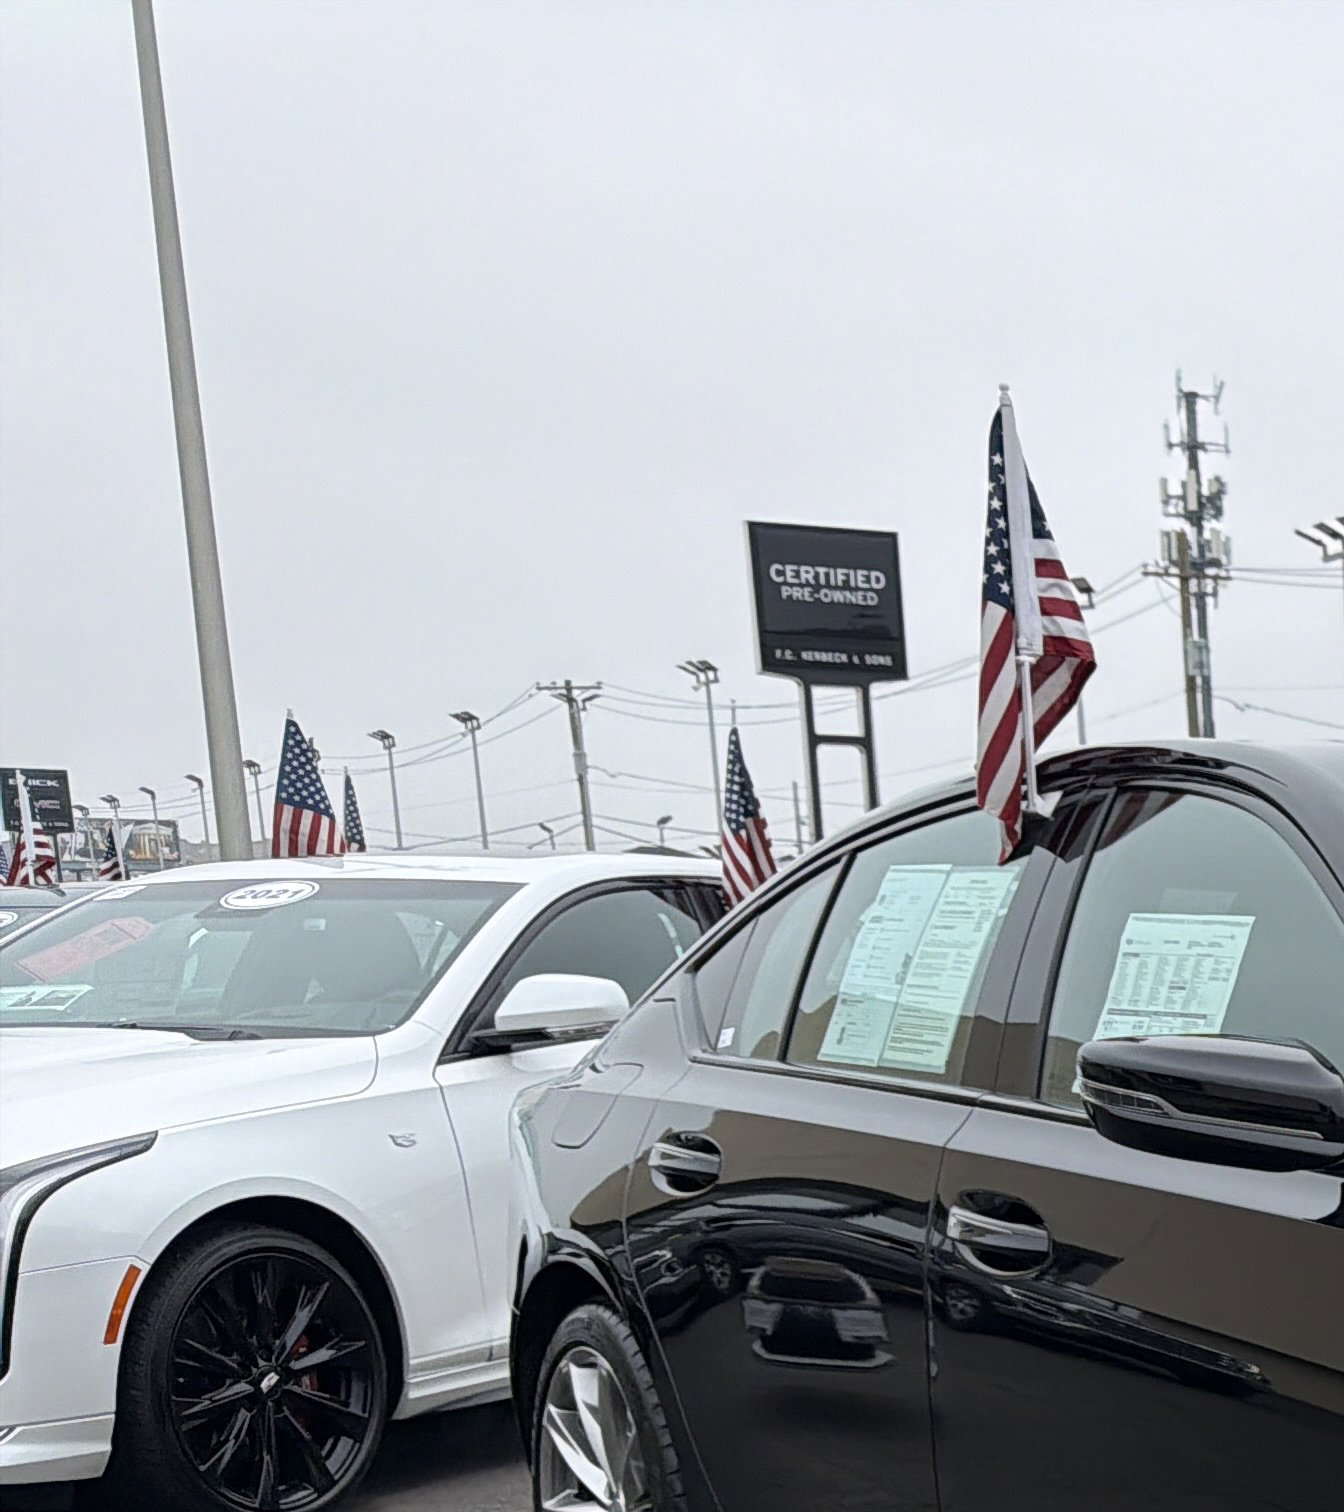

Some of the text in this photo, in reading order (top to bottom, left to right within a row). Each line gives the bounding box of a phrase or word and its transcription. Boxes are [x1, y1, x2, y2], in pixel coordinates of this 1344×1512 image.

[769, 563, 886, 590] CERTIFIED
[780, 585, 879, 606] PRE-OWNED
[231, 888, 307, 900] 2021
